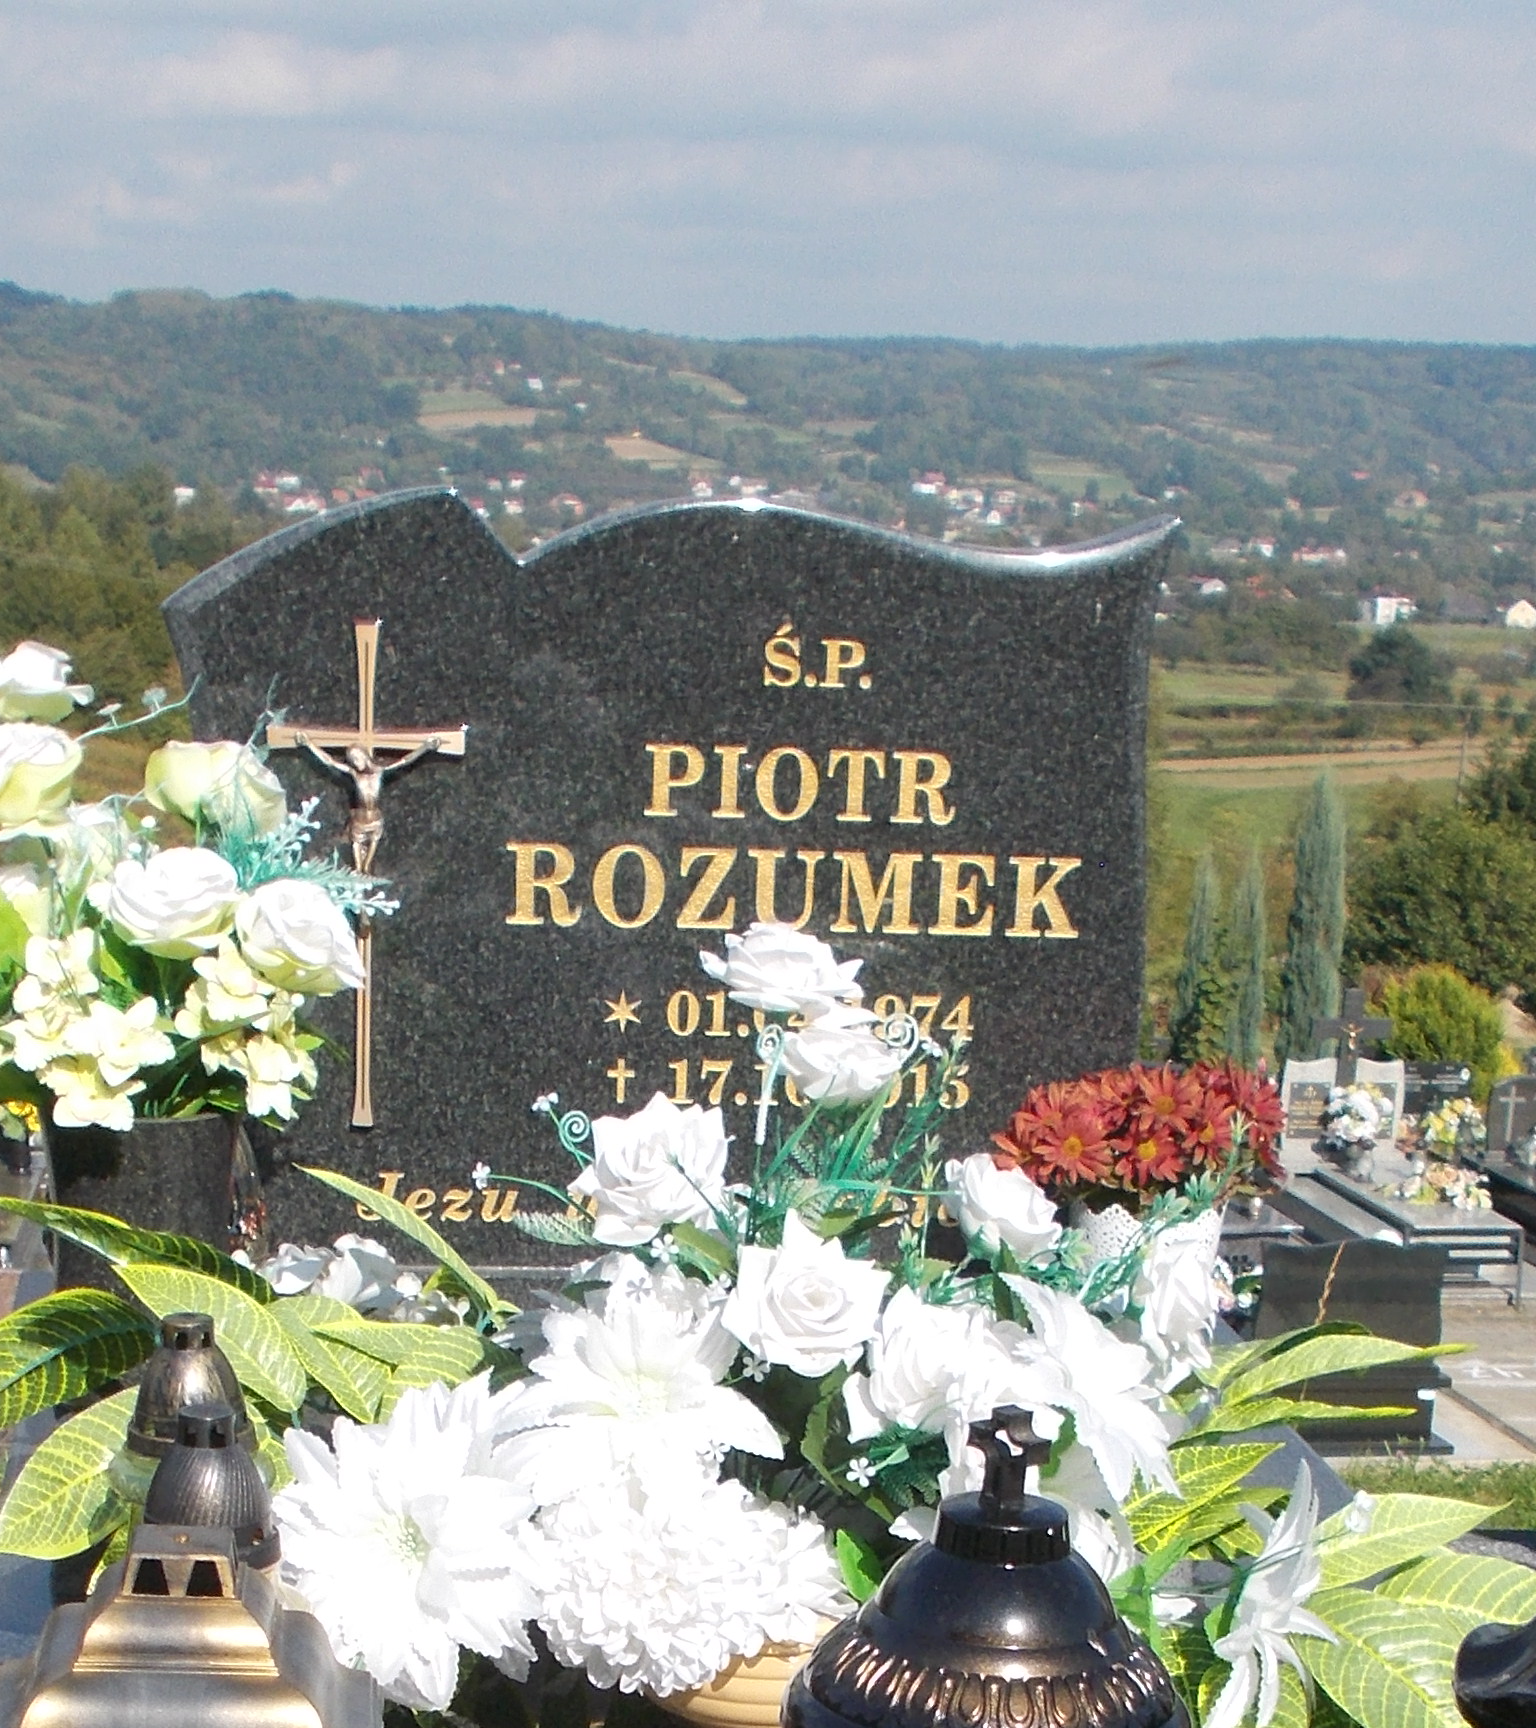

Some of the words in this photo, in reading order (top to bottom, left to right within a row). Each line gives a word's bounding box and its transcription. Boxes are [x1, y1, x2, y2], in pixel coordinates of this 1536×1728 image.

[763, 623, 873, 689] Ś.P.
[642, 743, 956, 826] PIOTR
[505, 841, 1083, 939] ROZUMEK
[355, 1171, 520, 1223] Jezu
